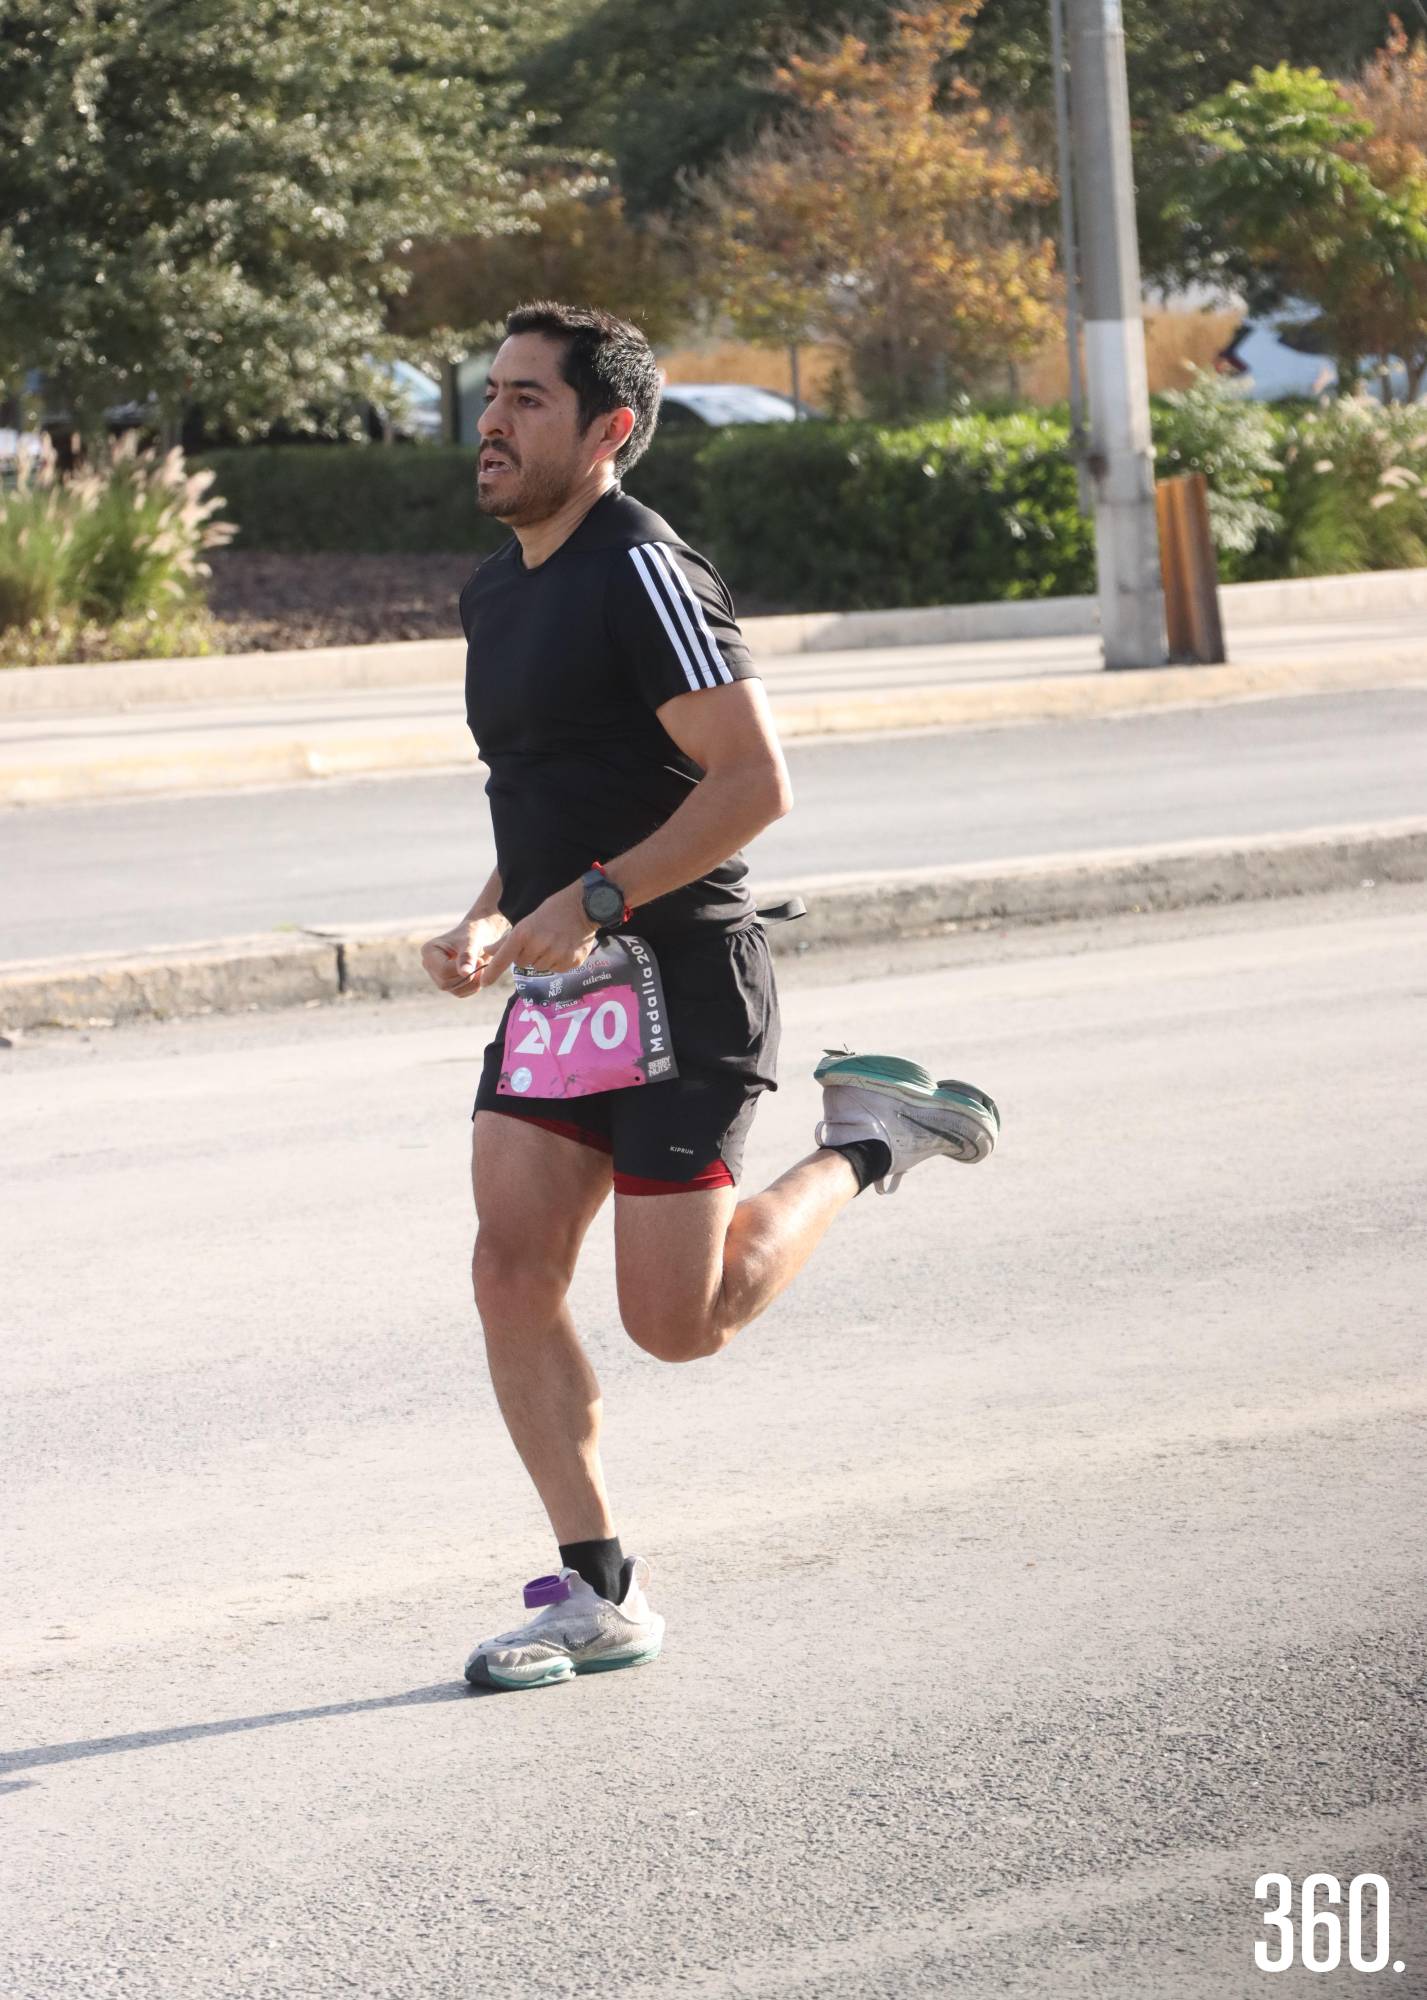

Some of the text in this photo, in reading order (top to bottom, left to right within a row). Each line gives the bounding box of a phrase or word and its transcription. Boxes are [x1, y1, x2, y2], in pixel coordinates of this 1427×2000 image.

[641, 966, 665, 1053] Medalla
[647, 1055, 671, 1069] BERRY
[669, 1145, 694, 1155] KIPRUN
